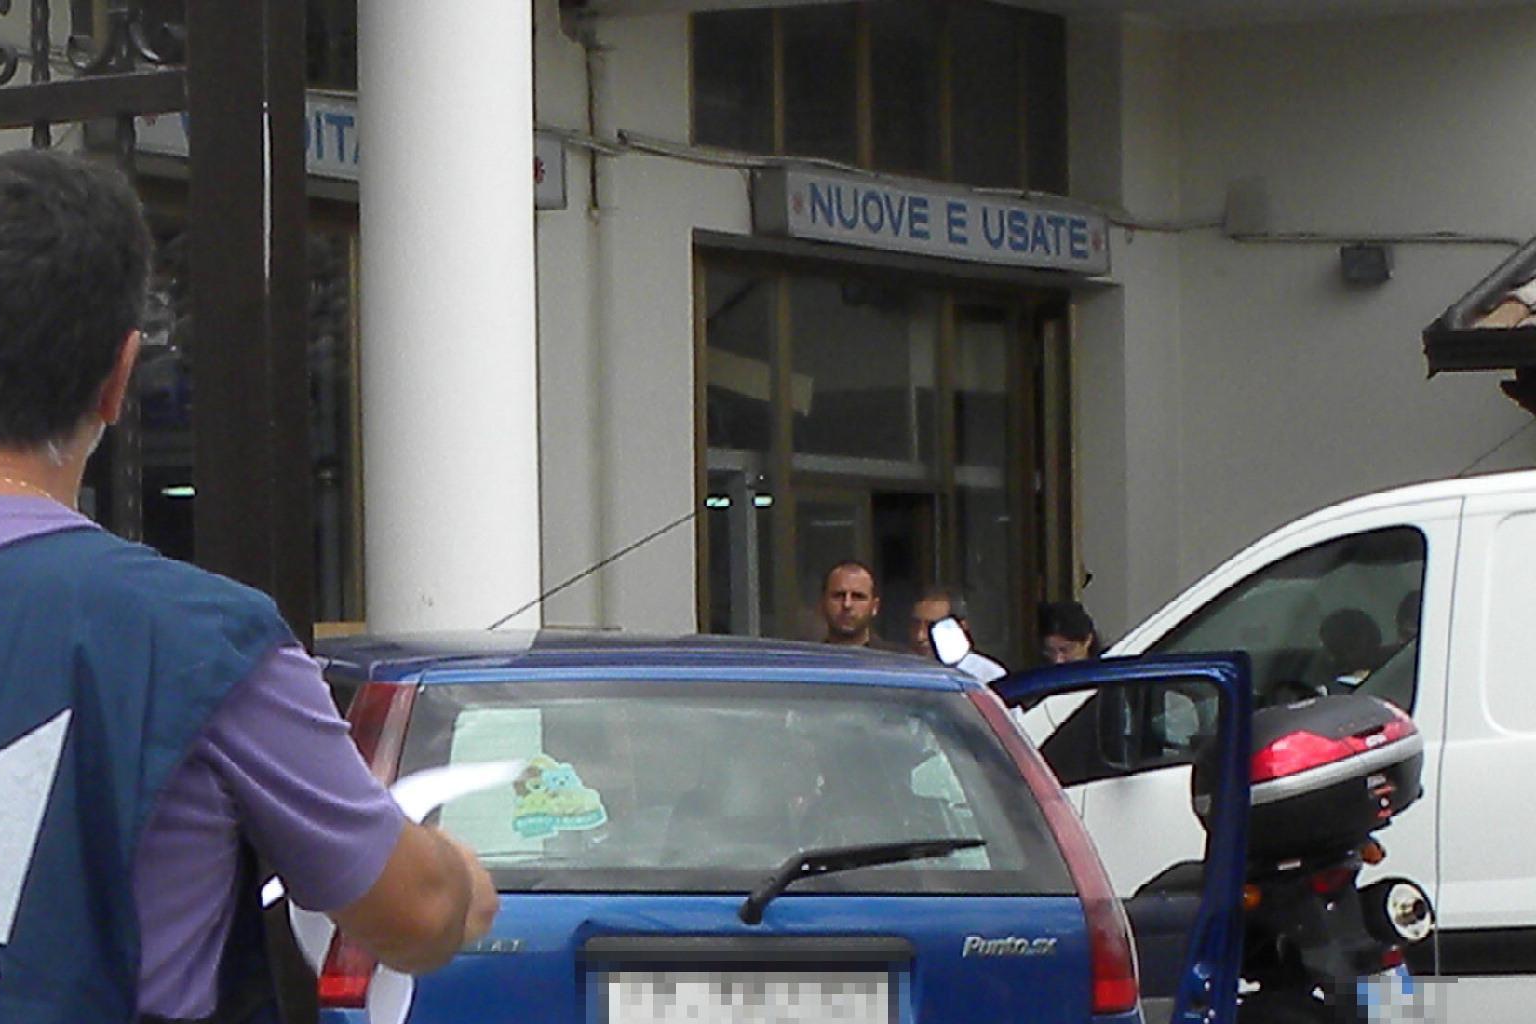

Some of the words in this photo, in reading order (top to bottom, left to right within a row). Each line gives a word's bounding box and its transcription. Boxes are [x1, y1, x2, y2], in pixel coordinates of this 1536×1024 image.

[808, 182, 930, 241] NUOVE
[946, 201, 968, 244] E
[981, 206, 1090, 260] USATE
